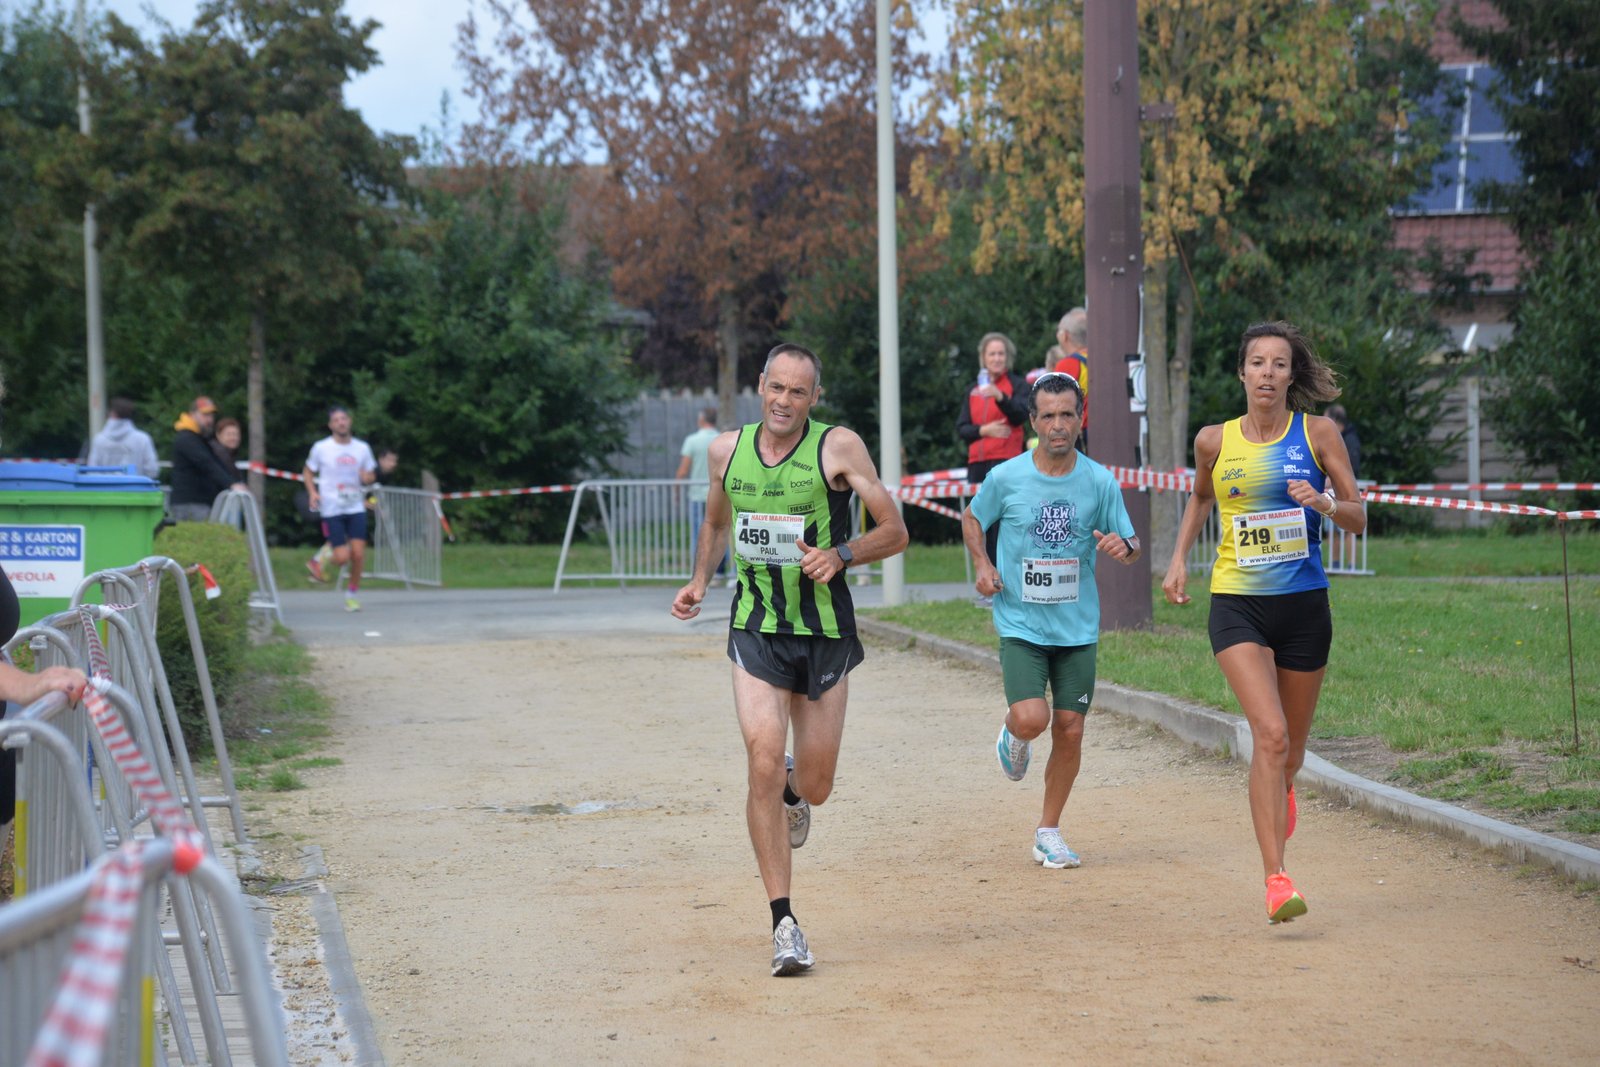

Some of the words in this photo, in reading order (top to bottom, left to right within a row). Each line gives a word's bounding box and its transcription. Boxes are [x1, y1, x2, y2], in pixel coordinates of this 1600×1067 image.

[751, 514, 768, 522] HALVE
[1041, 506, 1069, 519] NEW
[1248, 514, 1267, 522] HALVE
[1268, 510, 1302, 519] MARATHON
[1036, 519, 1070, 535] YORK
[11, 531, 22, 543] &
[25, 532, 77, 543] KARTON
[739, 528, 770, 545] 459
[1043, 530, 1070, 541] CITY
[1239, 528, 1270, 547] 219
[11, 544, 22, 556] &
[24, 545, 77, 557] CARTON
[760, 547, 779, 555] PAUL
[1262, 545, 1282, 554] ELKE
[1249, 551, 1306, 564] www.plusprint.be
[7, 572, 56, 582] VEOLIA
[1025, 571, 1053, 587] 605
